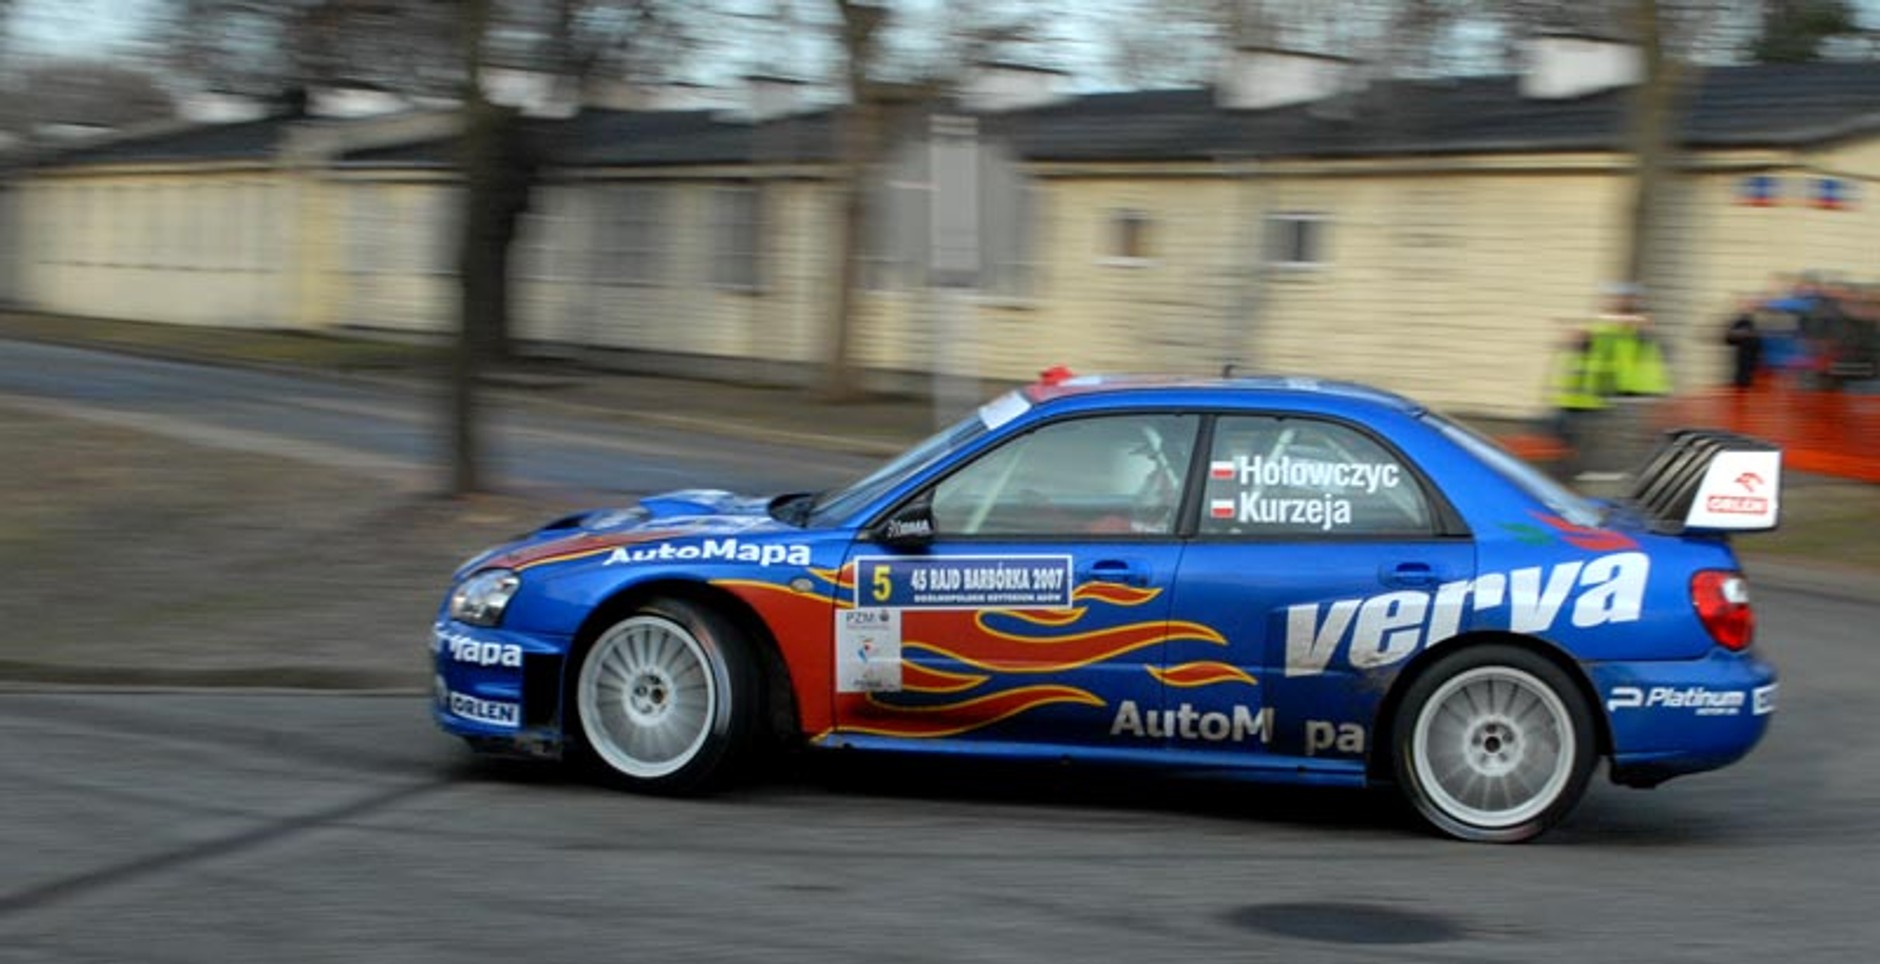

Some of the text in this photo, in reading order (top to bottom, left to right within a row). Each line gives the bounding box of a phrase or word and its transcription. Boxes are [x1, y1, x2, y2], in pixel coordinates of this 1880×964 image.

[1240, 456, 1399, 493] Hołowczyc
[1239, 491, 1351, 530] Kurzeja
[602, 538, 811, 566] AutoMapa
[873, 565, 892, 600] 5
[911, 562, 1065, 591] 45 RAJD BARBÓRKA 2007
[1285, 552, 1650, 678] verva
[453, 695, 515, 723] ORLEN
[1645, 687, 1746, 707] Platinum
